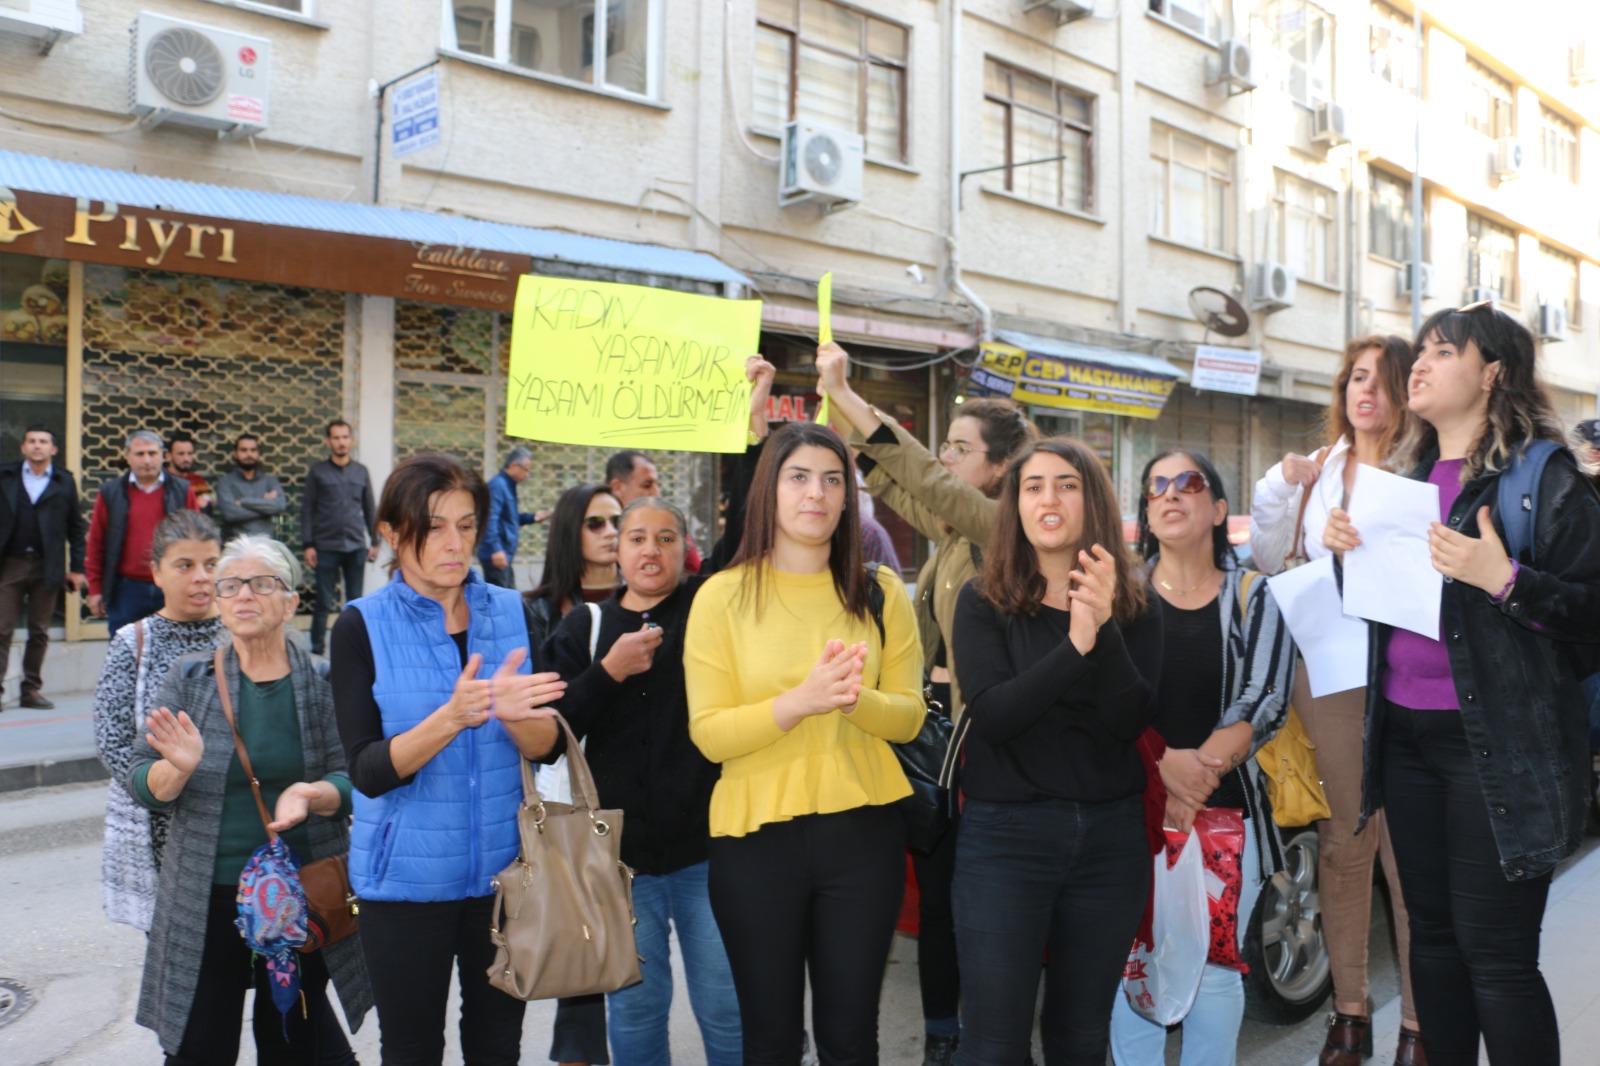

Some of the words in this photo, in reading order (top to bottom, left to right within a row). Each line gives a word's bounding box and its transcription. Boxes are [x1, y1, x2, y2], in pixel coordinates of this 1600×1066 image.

[239, 67, 255, 79] LG
[531, 286, 645, 330] KADIN
[592, 334, 731, 384] YAŞAMDIR
[982, 350, 1022, 368] CEP
[1025, 358, 1067, 380] CEP
[512, 372, 604, 419] YAŞAMI
